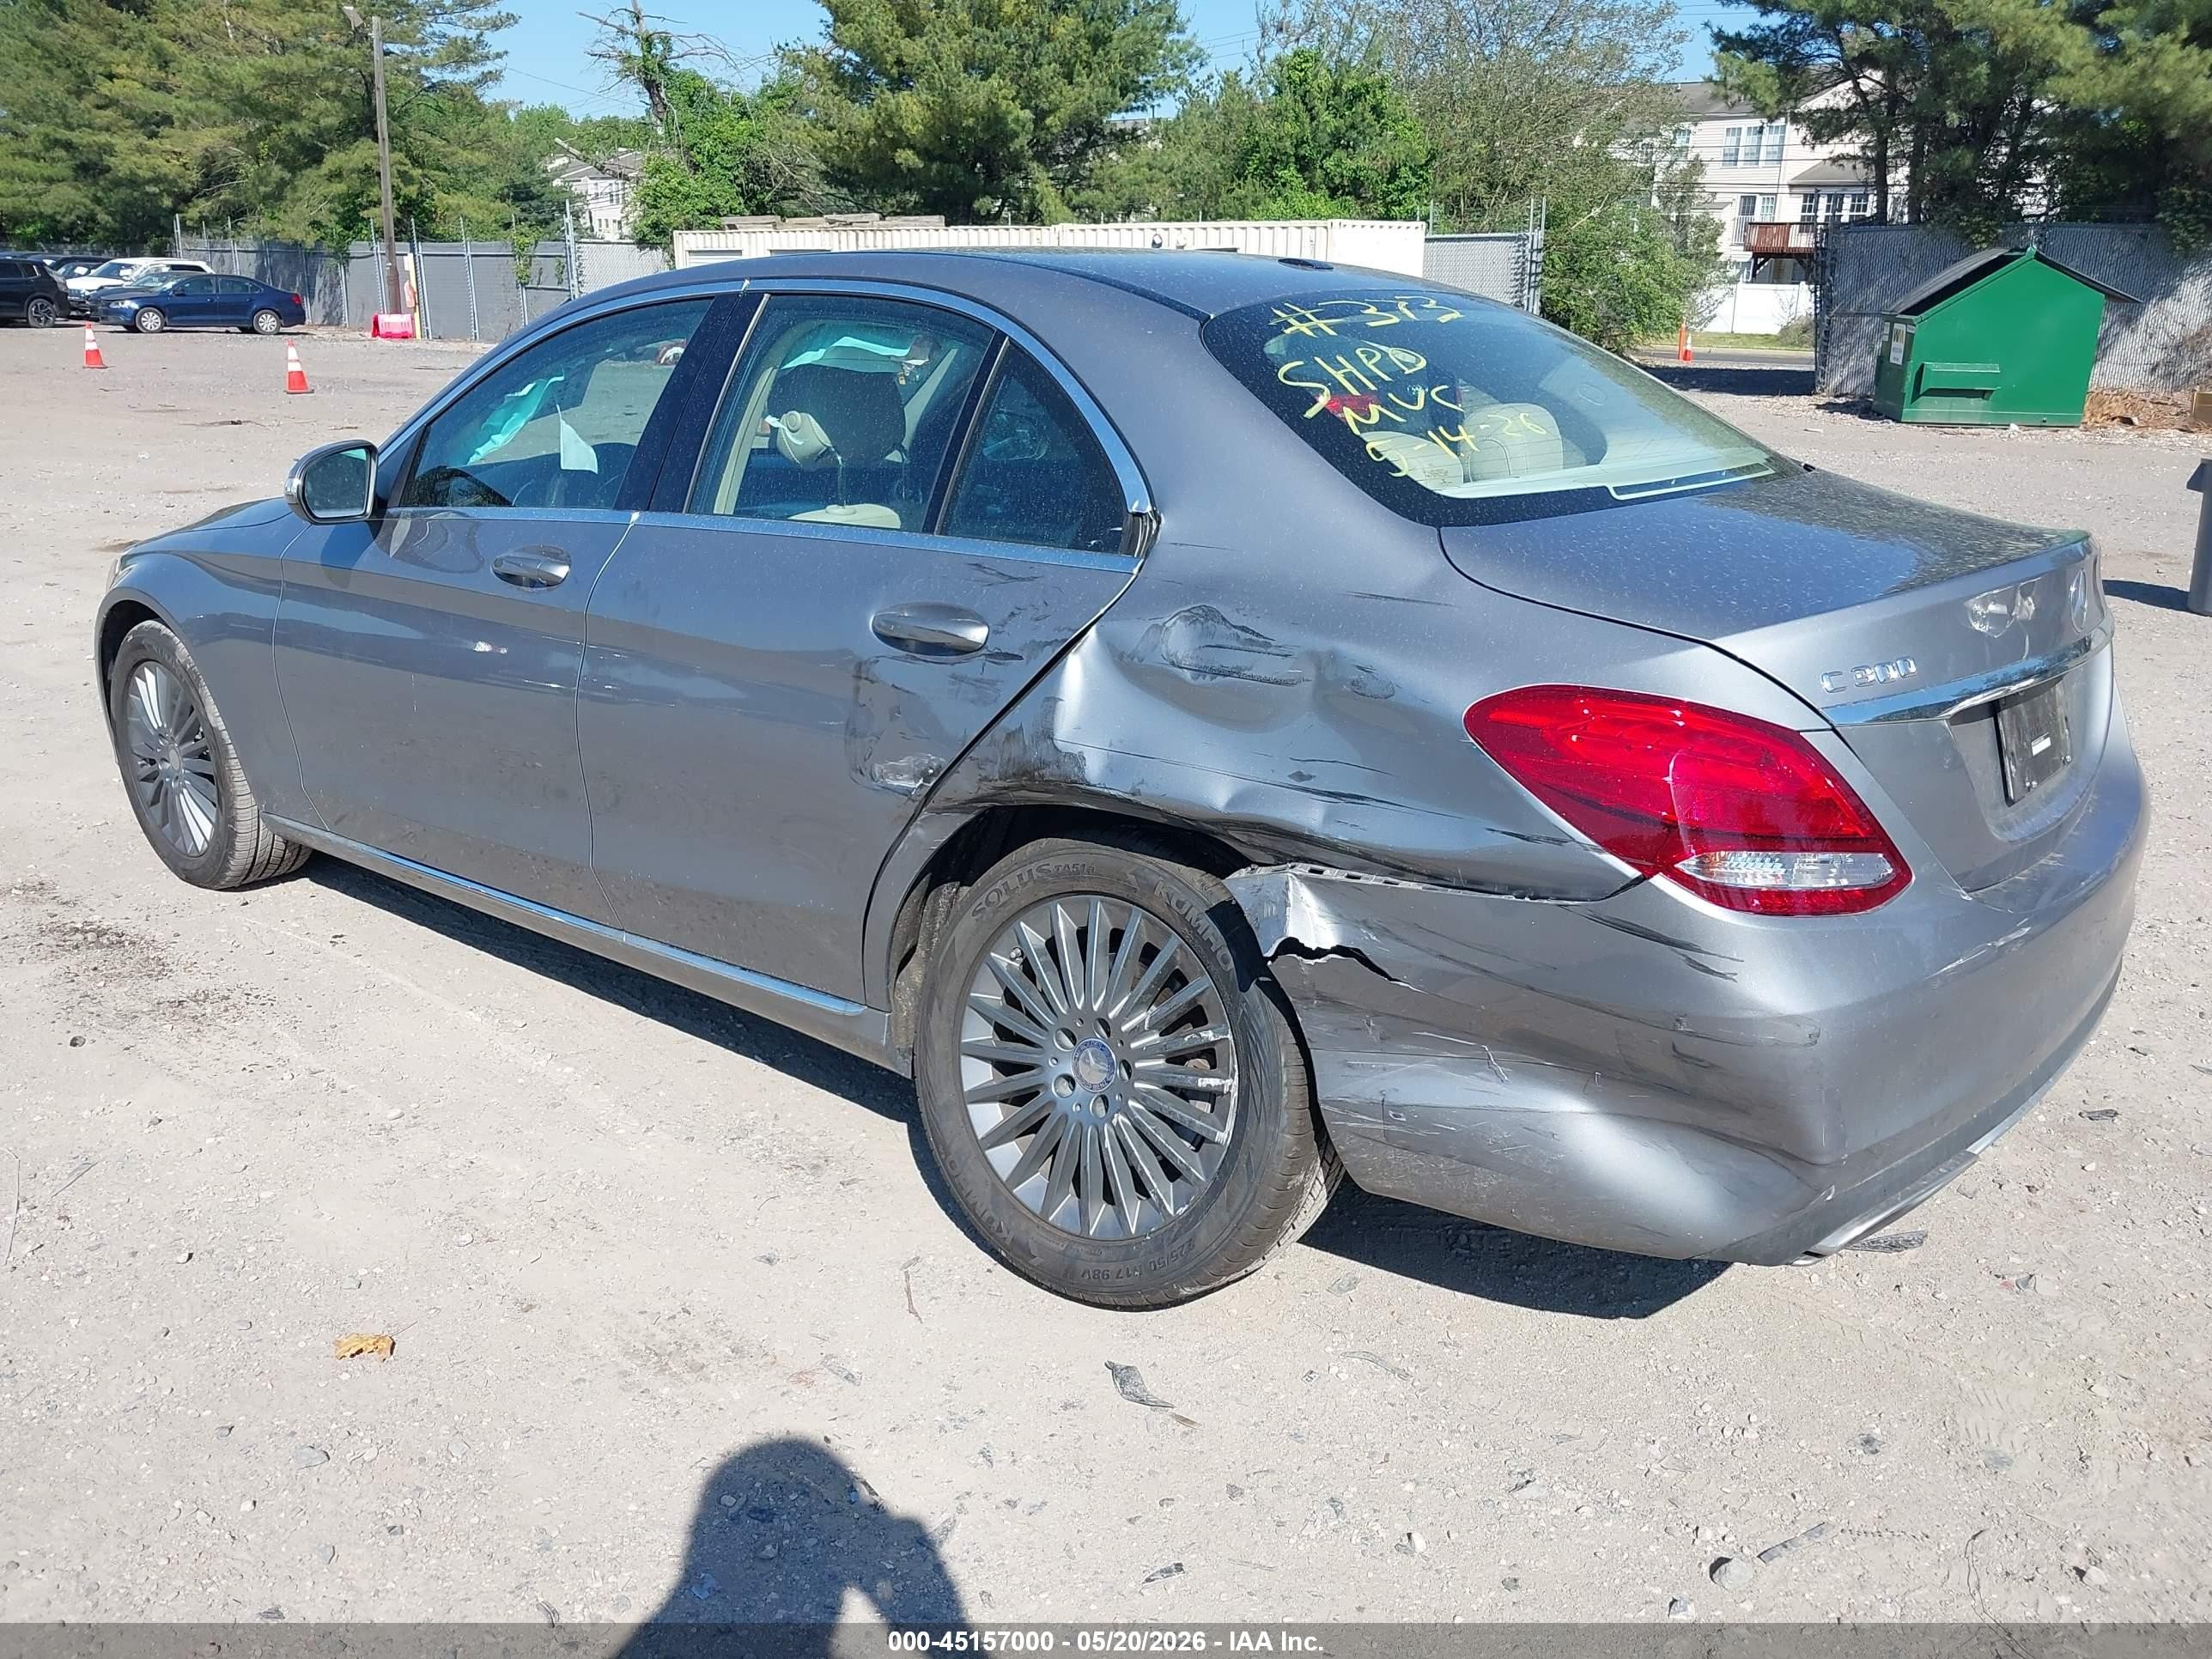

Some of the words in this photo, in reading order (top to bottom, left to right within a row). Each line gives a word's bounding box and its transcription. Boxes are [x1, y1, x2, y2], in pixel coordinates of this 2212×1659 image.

[1278, 340, 1427, 419] SHPD
[1820, 672, 1847, 693] C
[1850, 657, 1917, 687] 300
[971, 863, 1052, 918] SOLUS
[1153, 880, 1234, 972] KUMHO
